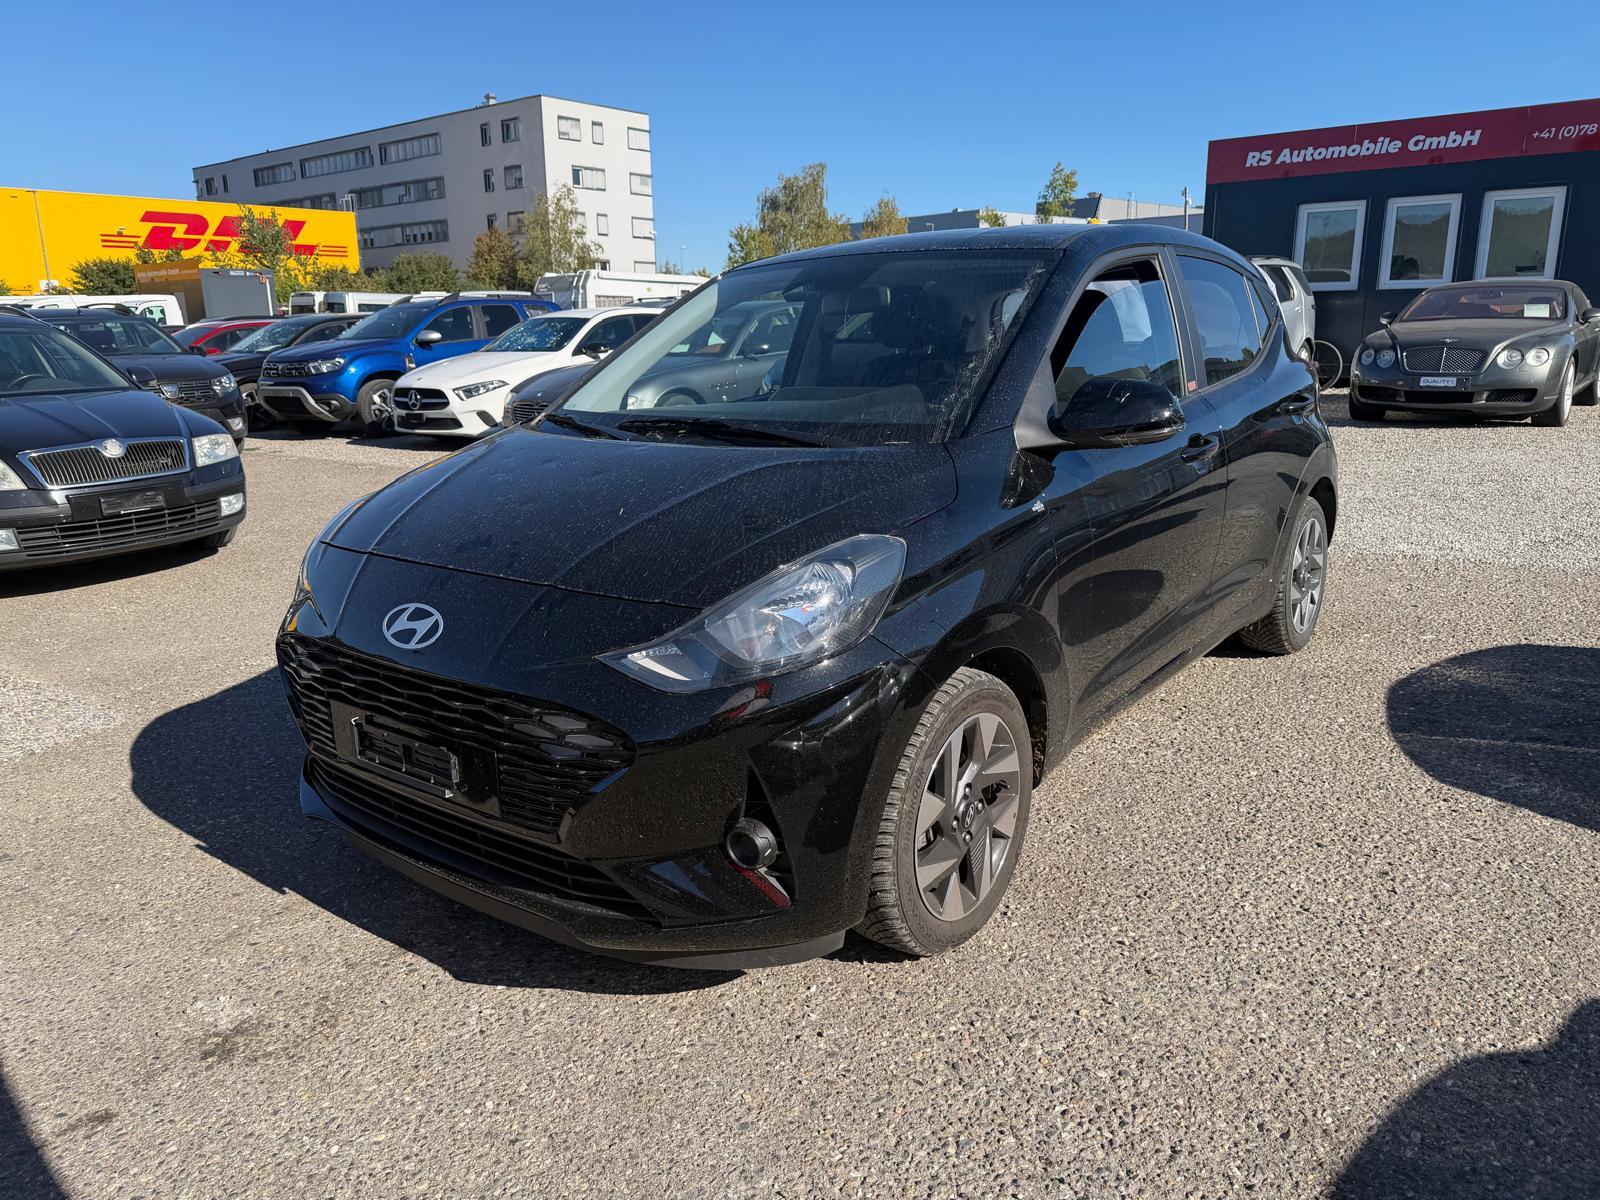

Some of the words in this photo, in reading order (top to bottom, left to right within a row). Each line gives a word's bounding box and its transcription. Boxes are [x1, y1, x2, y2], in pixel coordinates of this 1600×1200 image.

[1532, 127, 1556, 139] +41
[1558, 123, 1599, 140] (0)78
[1245, 151, 1272, 167] RS
[1275, 137, 1402, 164] Automobile
[1407, 129, 1482, 151] GmbH
